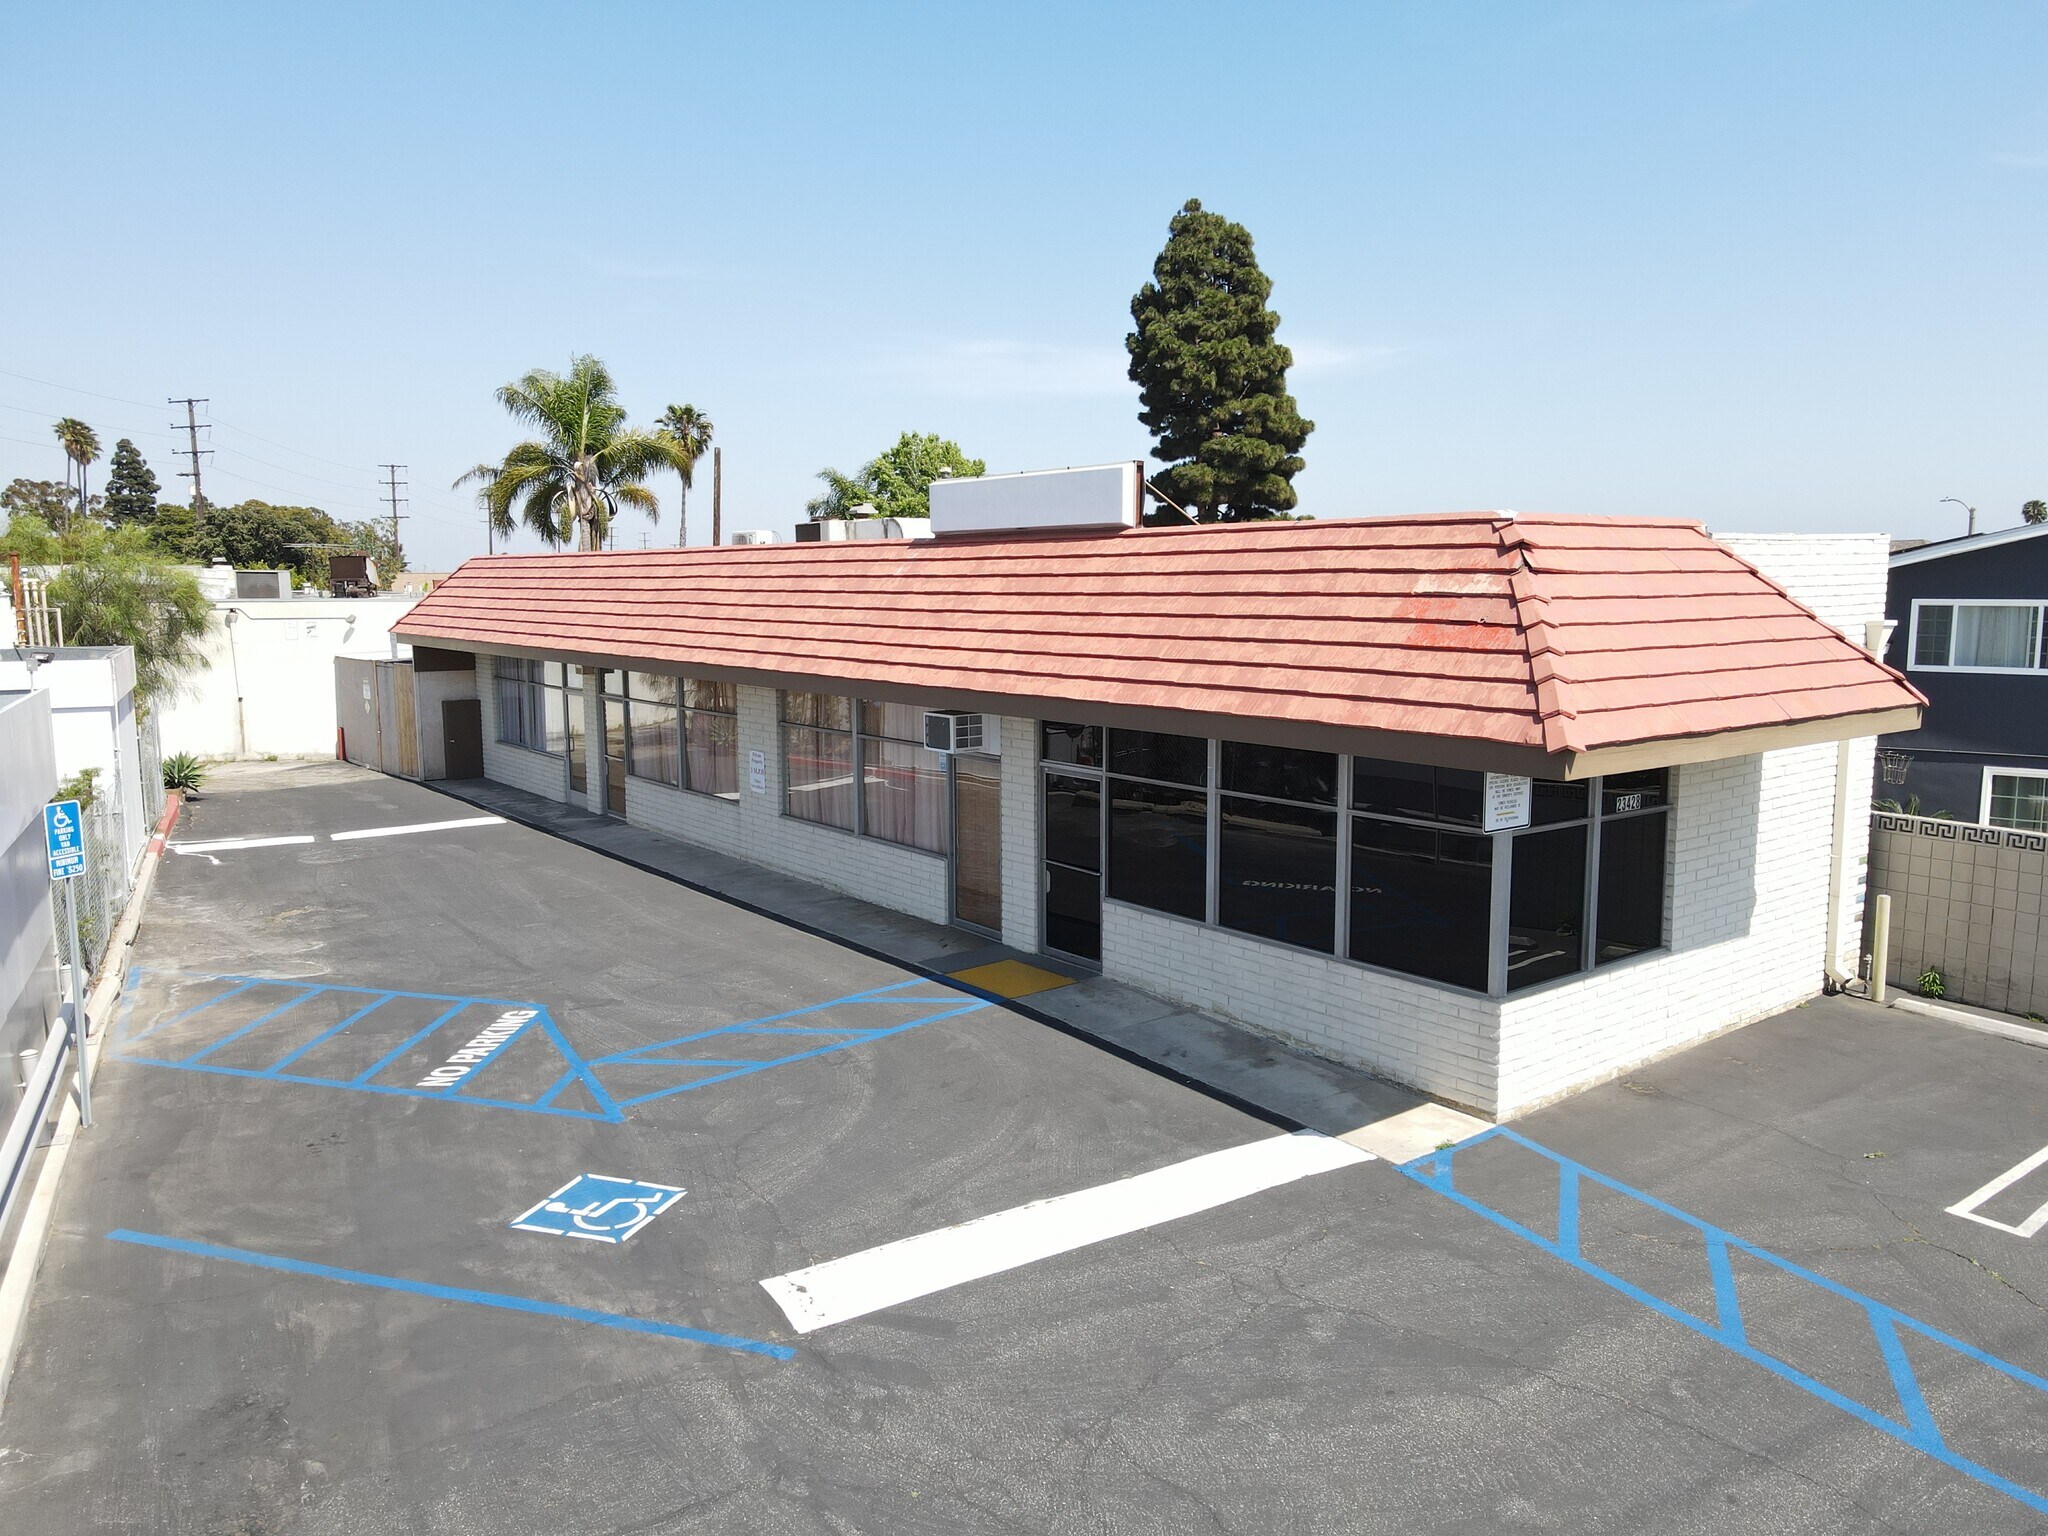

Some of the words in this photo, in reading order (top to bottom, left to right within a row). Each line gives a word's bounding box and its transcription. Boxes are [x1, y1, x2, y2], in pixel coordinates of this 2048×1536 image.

[1616, 794, 1641, 812] 23428
[54, 826, 75, 835] PARKING
[58, 833, 72, 841] ONLY
[60, 840, 71, 848] VAN
[52, 845, 80, 857] ACCESSIBLE
[55, 856, 79, 868] MINIMUM
[53, 867, 65, 877] FINE
[416, 1065, 471, 1087] NO
[445, 1010, 540, 1063] PARKING
